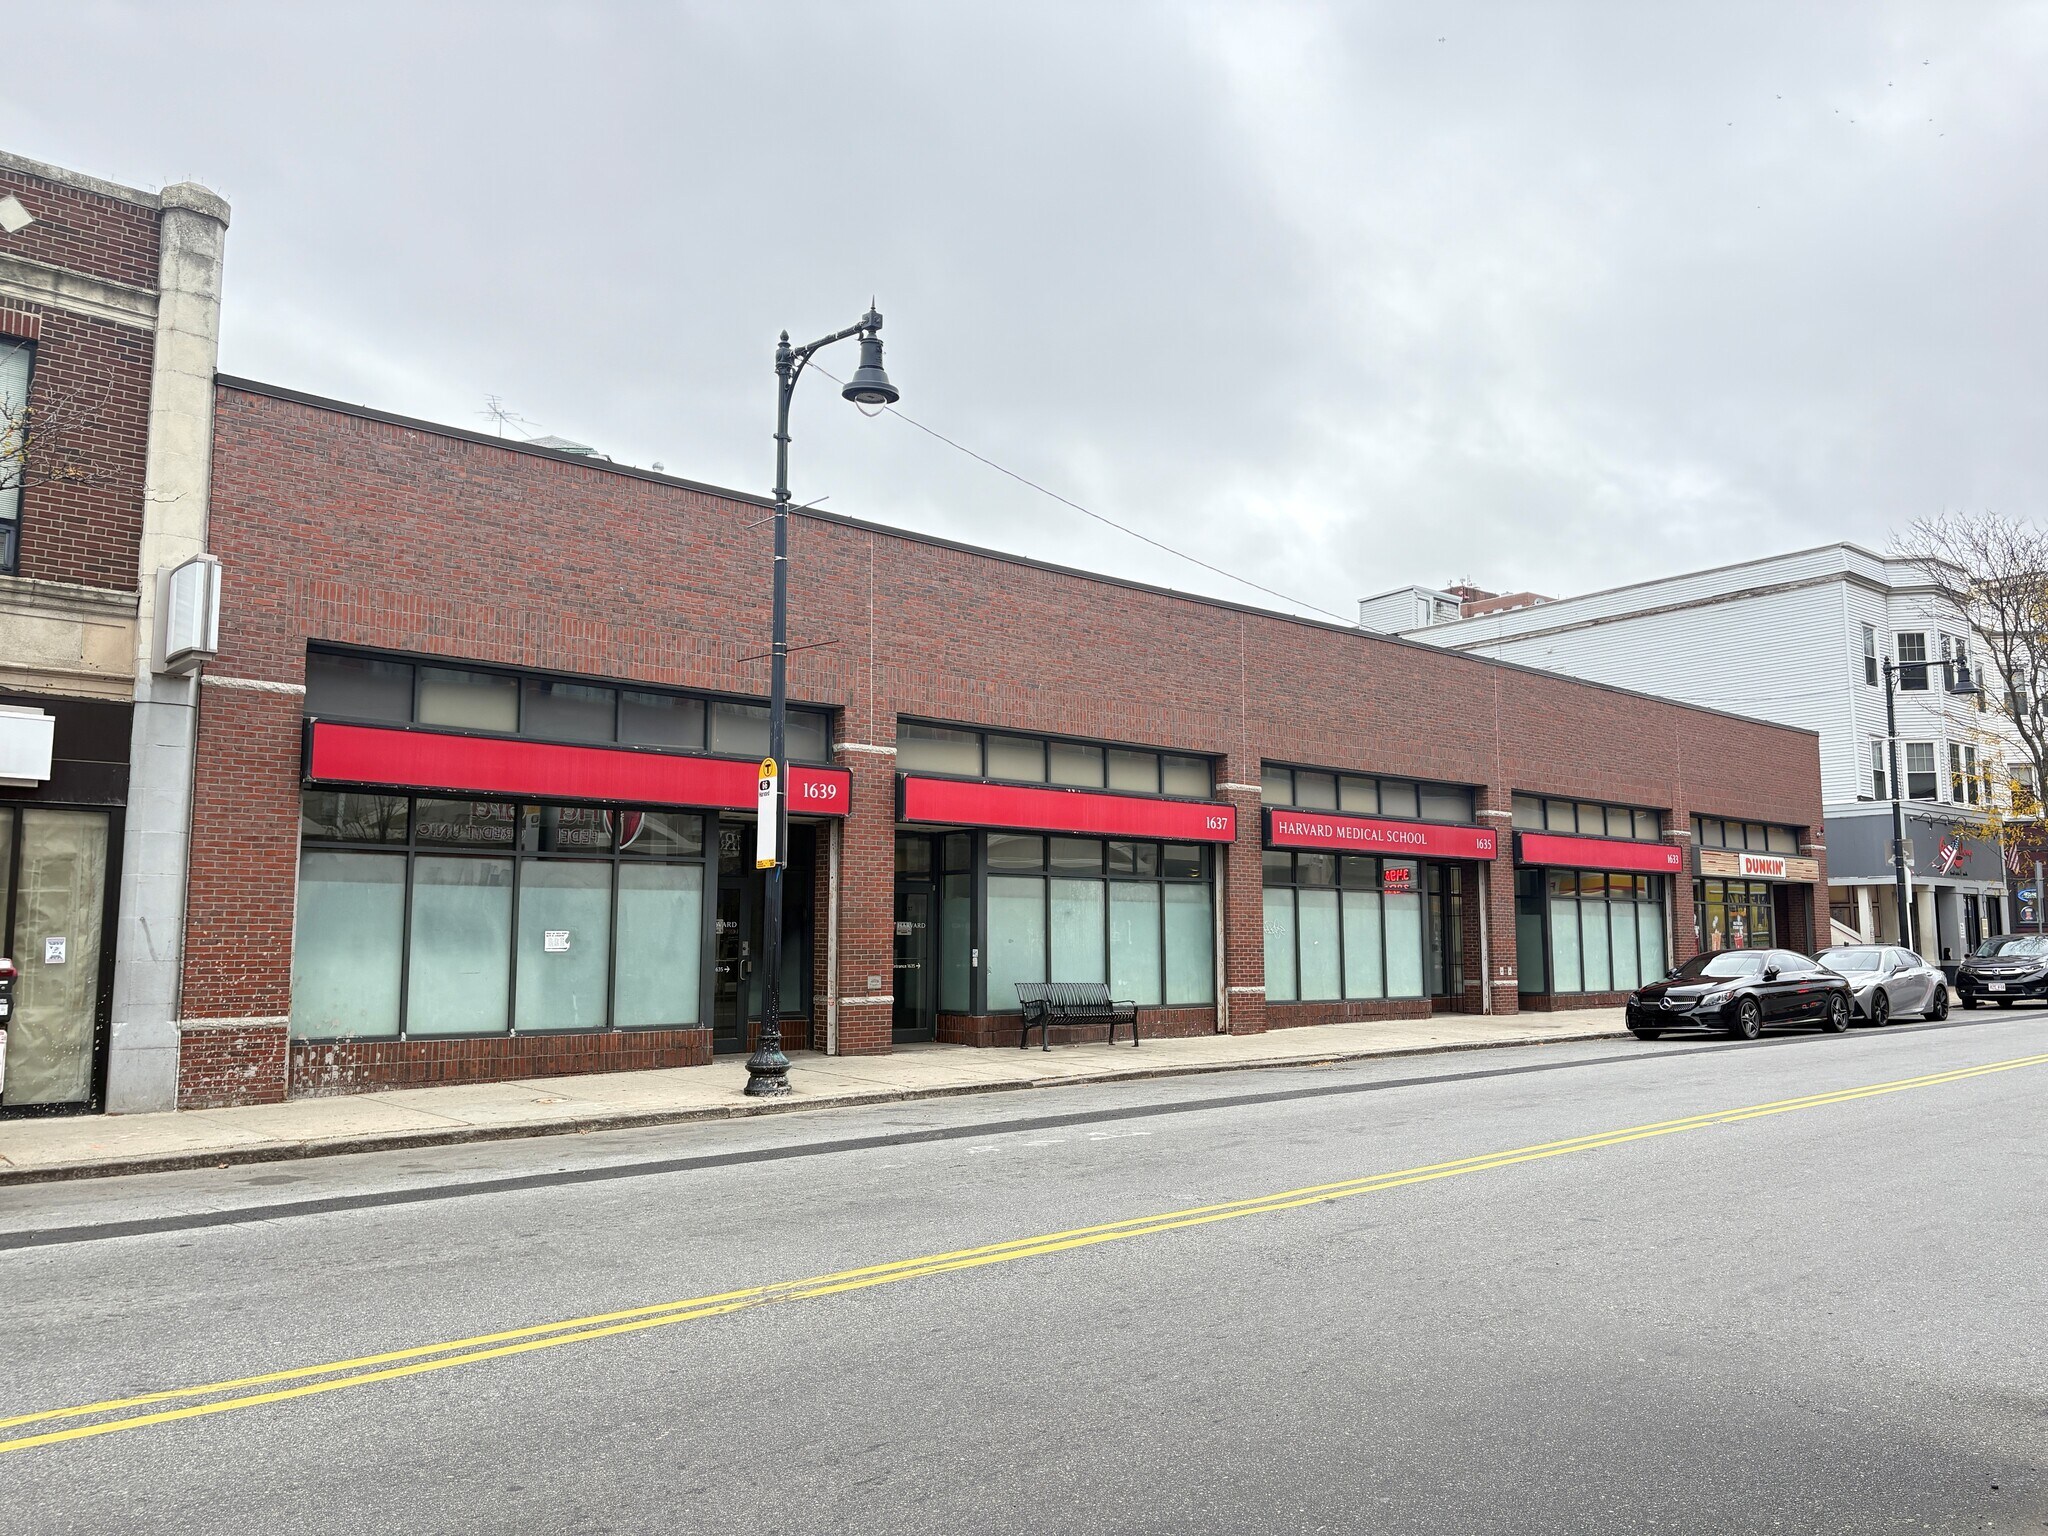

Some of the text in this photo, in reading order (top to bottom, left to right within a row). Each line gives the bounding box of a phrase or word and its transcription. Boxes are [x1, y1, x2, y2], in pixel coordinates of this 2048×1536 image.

[803, 782, 837, 800] 1639
[1206, 816, 1228, 830] 1637
[1279, 821, 1428, 845] HARVARD MEDICAL SCHOOL
[1476, 838, 1492, 850] 1635
[1667, 854, 1679, 864] 1633
[1745, 857, 1784, 875] DUNKIN'
